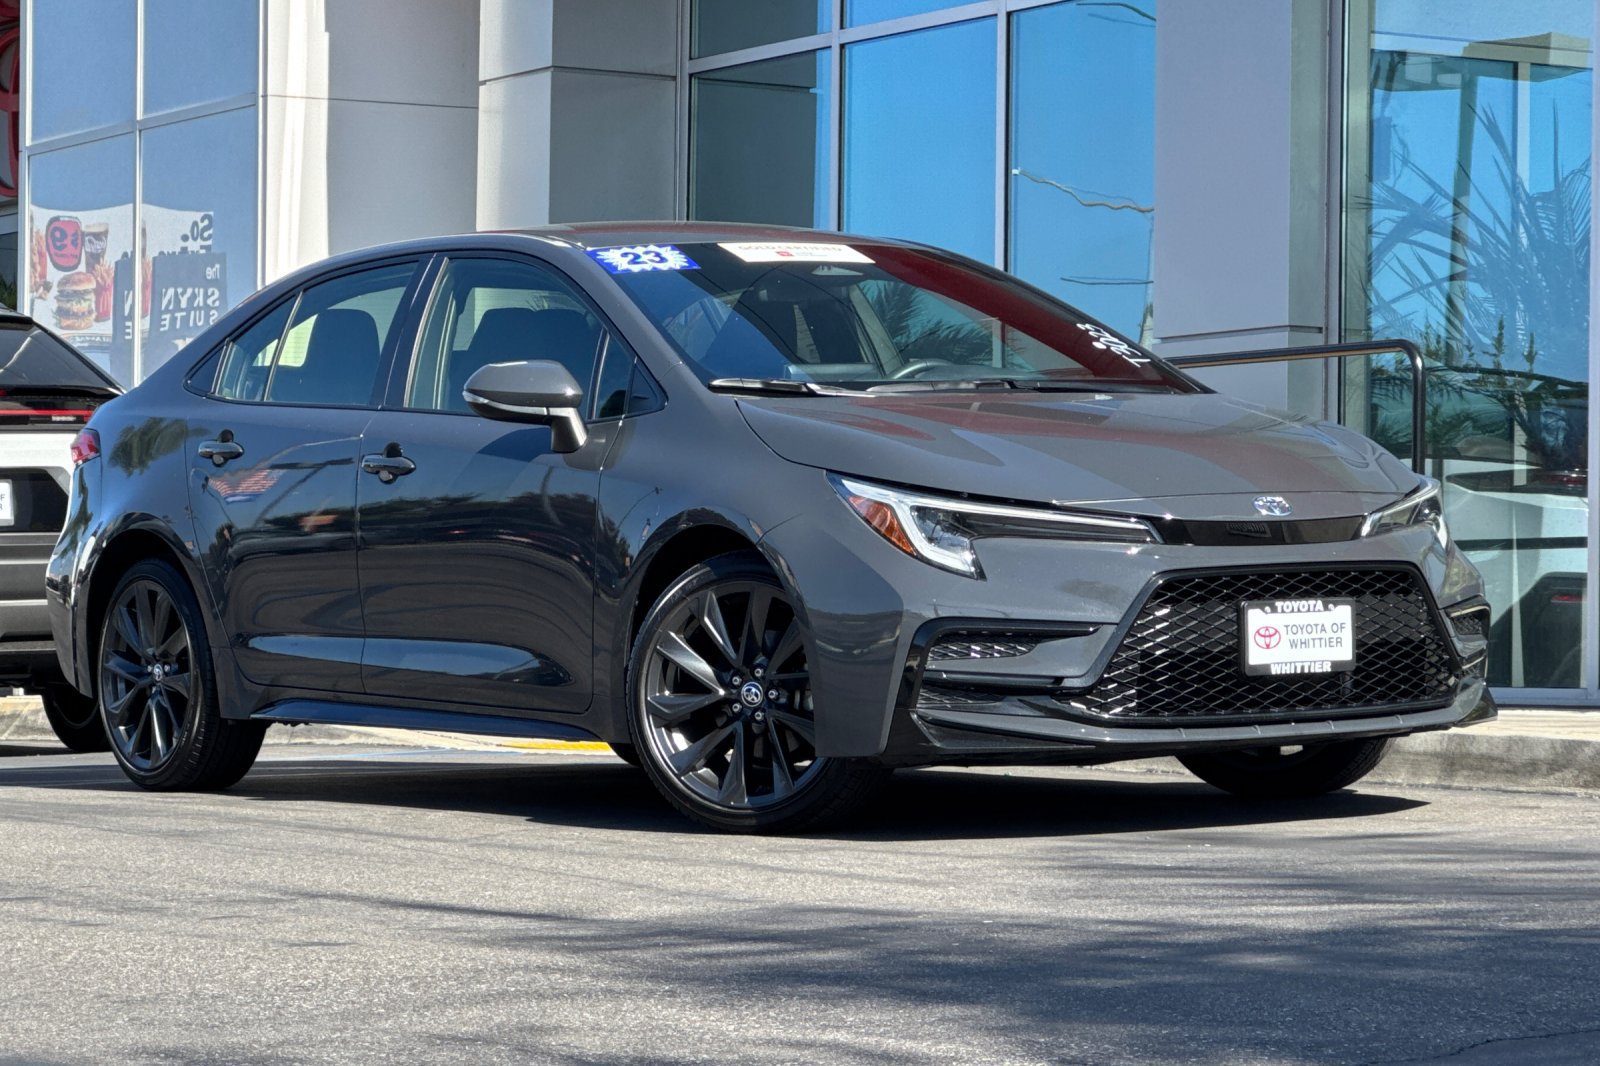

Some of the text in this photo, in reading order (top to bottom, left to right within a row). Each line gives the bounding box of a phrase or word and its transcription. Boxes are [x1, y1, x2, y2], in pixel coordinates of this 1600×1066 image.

[620, 250, 668, 265] 23
[1275, 600, 1324, 612] TOYOTA
[1283, 622, 1346, 635] TOYOTA OF
[1289, 637, 1343, 649] WHITTIER
[1270, 661, 1331, 674] WHITTIER
